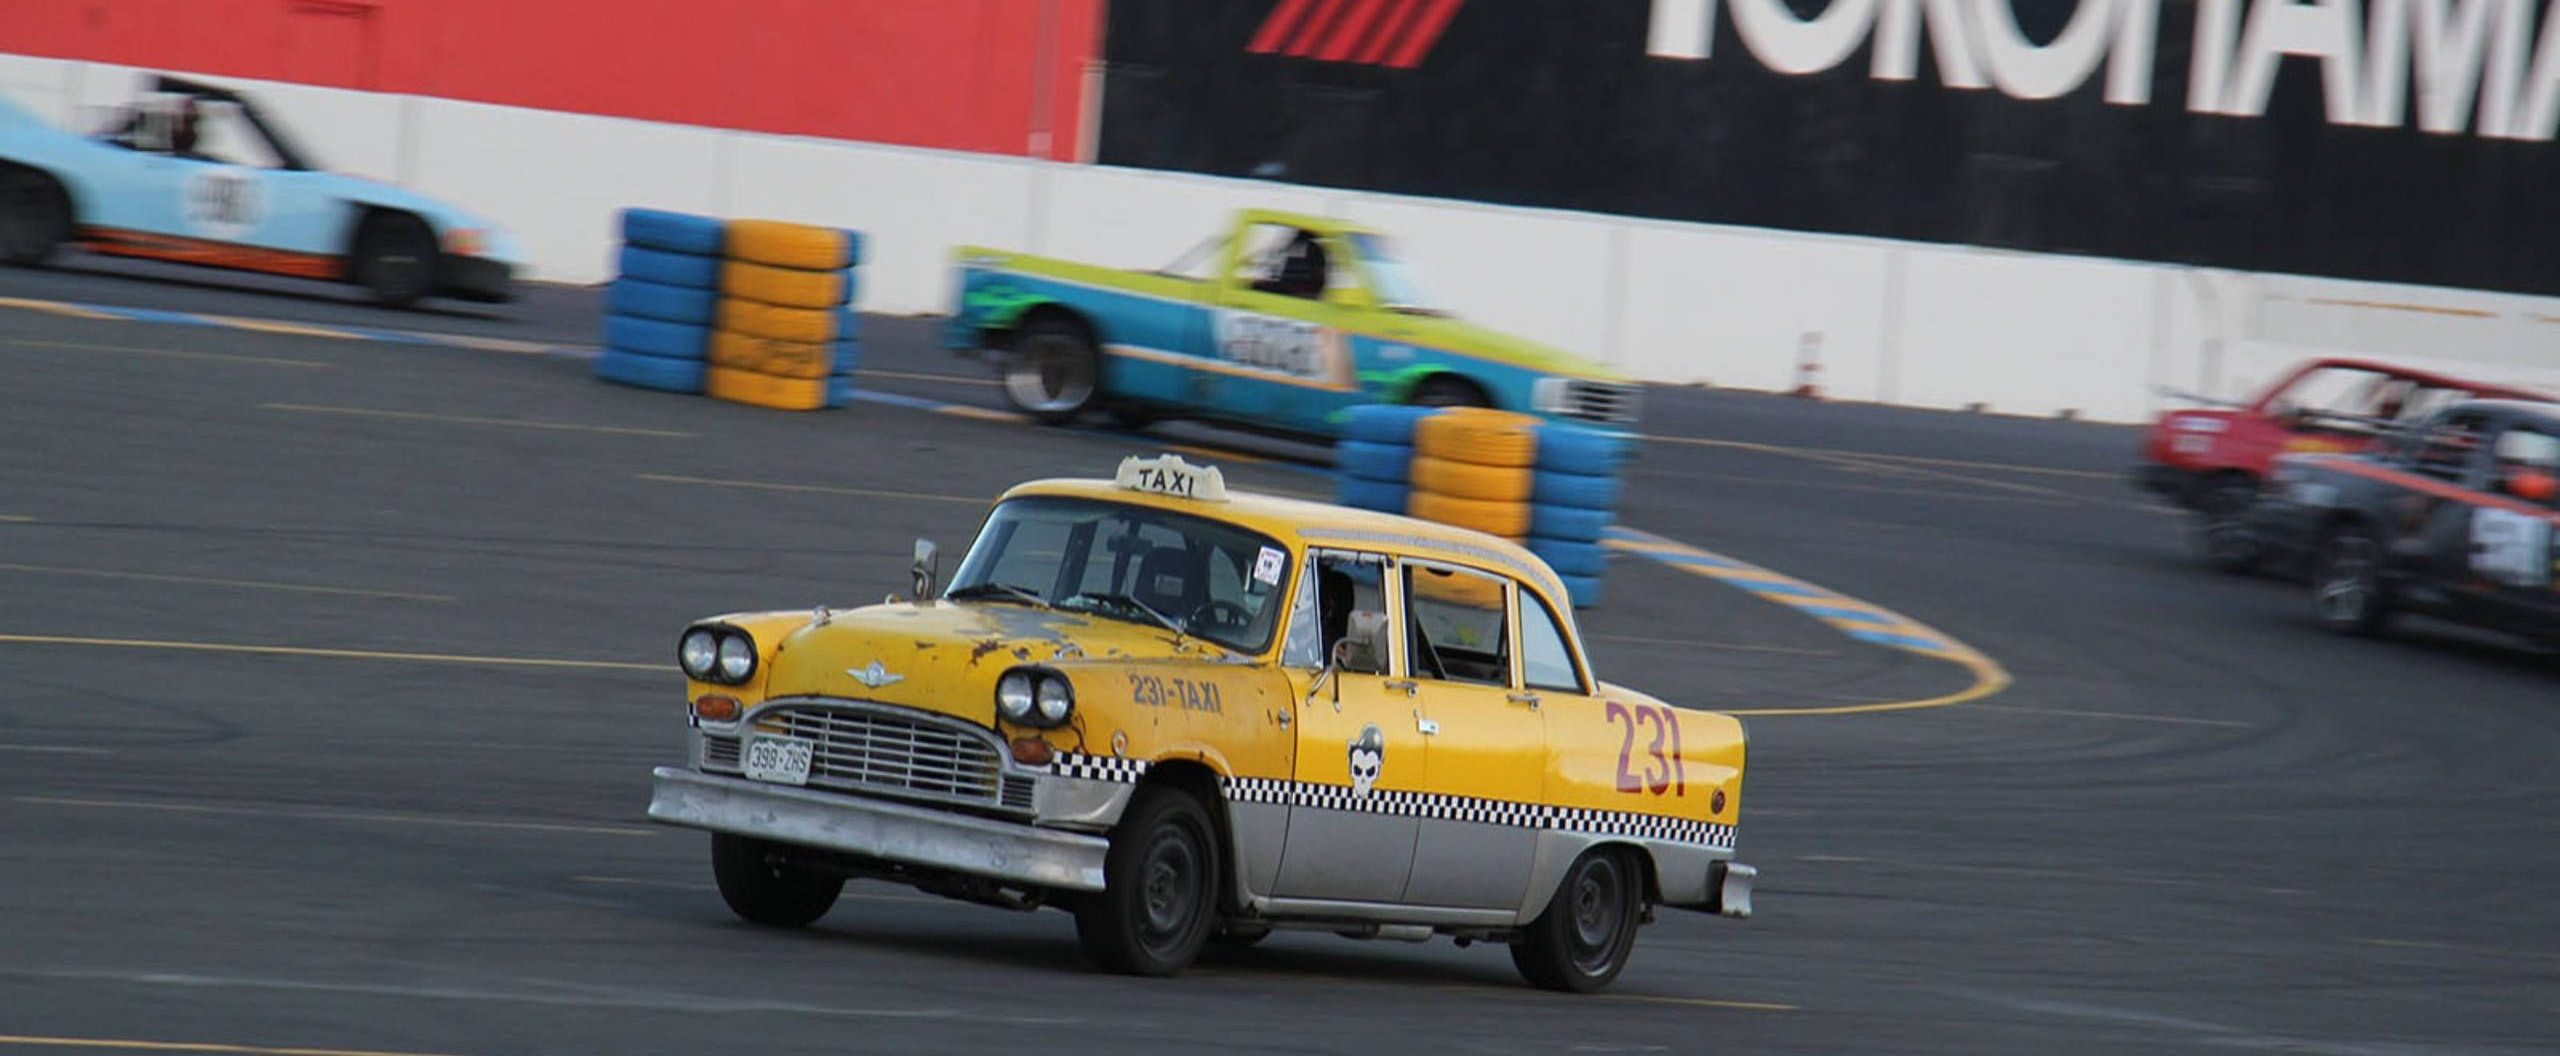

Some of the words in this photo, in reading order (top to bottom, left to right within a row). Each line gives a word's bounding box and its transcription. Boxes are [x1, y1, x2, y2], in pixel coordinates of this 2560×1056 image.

[1139, 468, 1194, 496] TAXI
[1129, 673, 1223, 714] 231-TAXI
[1605, 701, 1684, 797] 231
